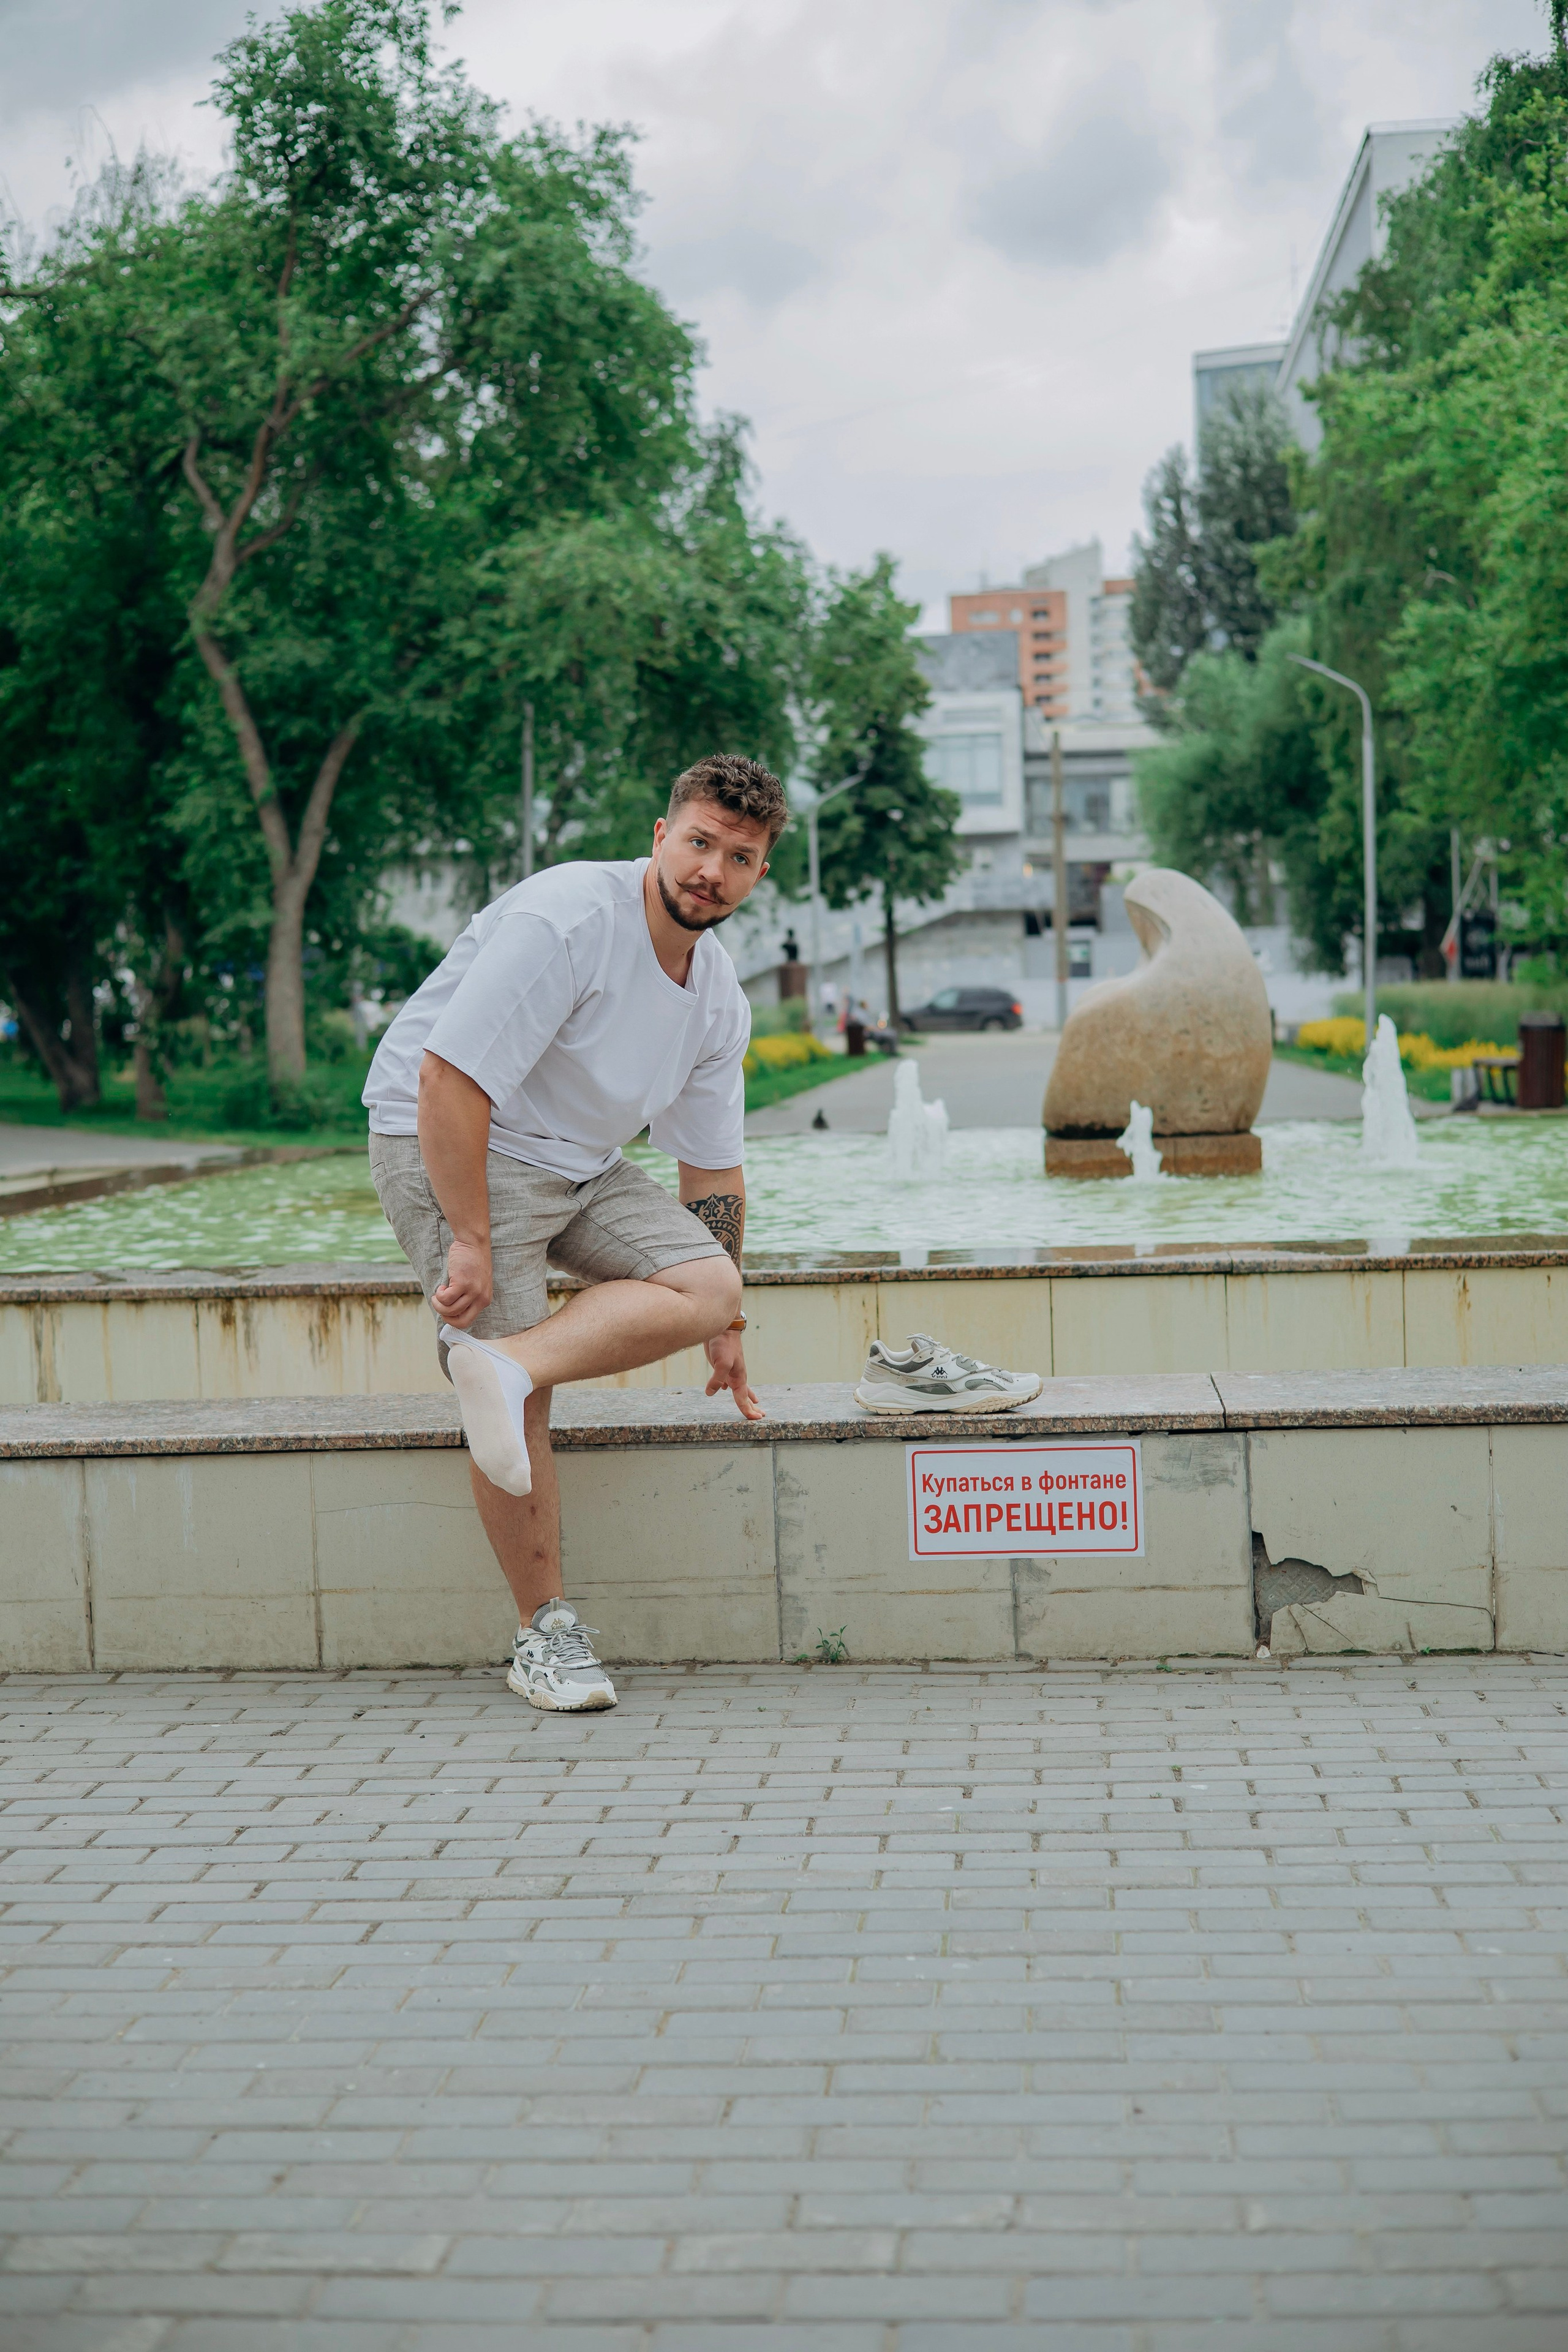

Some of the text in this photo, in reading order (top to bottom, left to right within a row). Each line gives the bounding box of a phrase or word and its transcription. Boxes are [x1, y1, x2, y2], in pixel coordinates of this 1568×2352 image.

[922, 1470, 1126, 1498] Купаться в фонтане
[924, 1501, 1128, 1536] ЗАПРЕЩЕНО!
